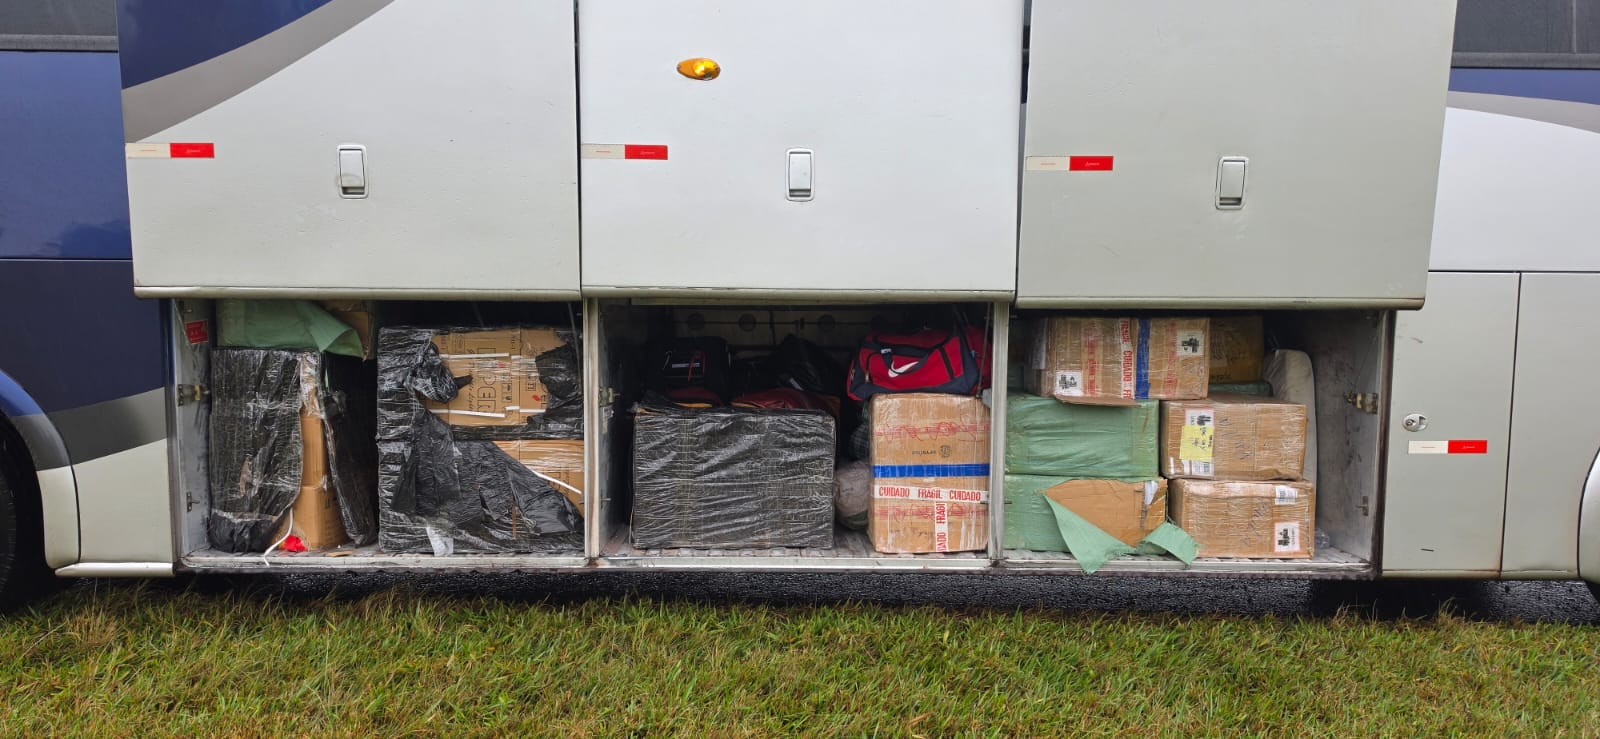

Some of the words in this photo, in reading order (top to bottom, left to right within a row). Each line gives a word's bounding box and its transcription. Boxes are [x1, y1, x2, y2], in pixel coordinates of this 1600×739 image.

[1123, 351, 1133, 382] CUIDADO
[879, 486, 910, 498] CUIDADO
[918, 488, 943, 500] FRAGIL
[949, 490, 981, 501] CUIDADO
